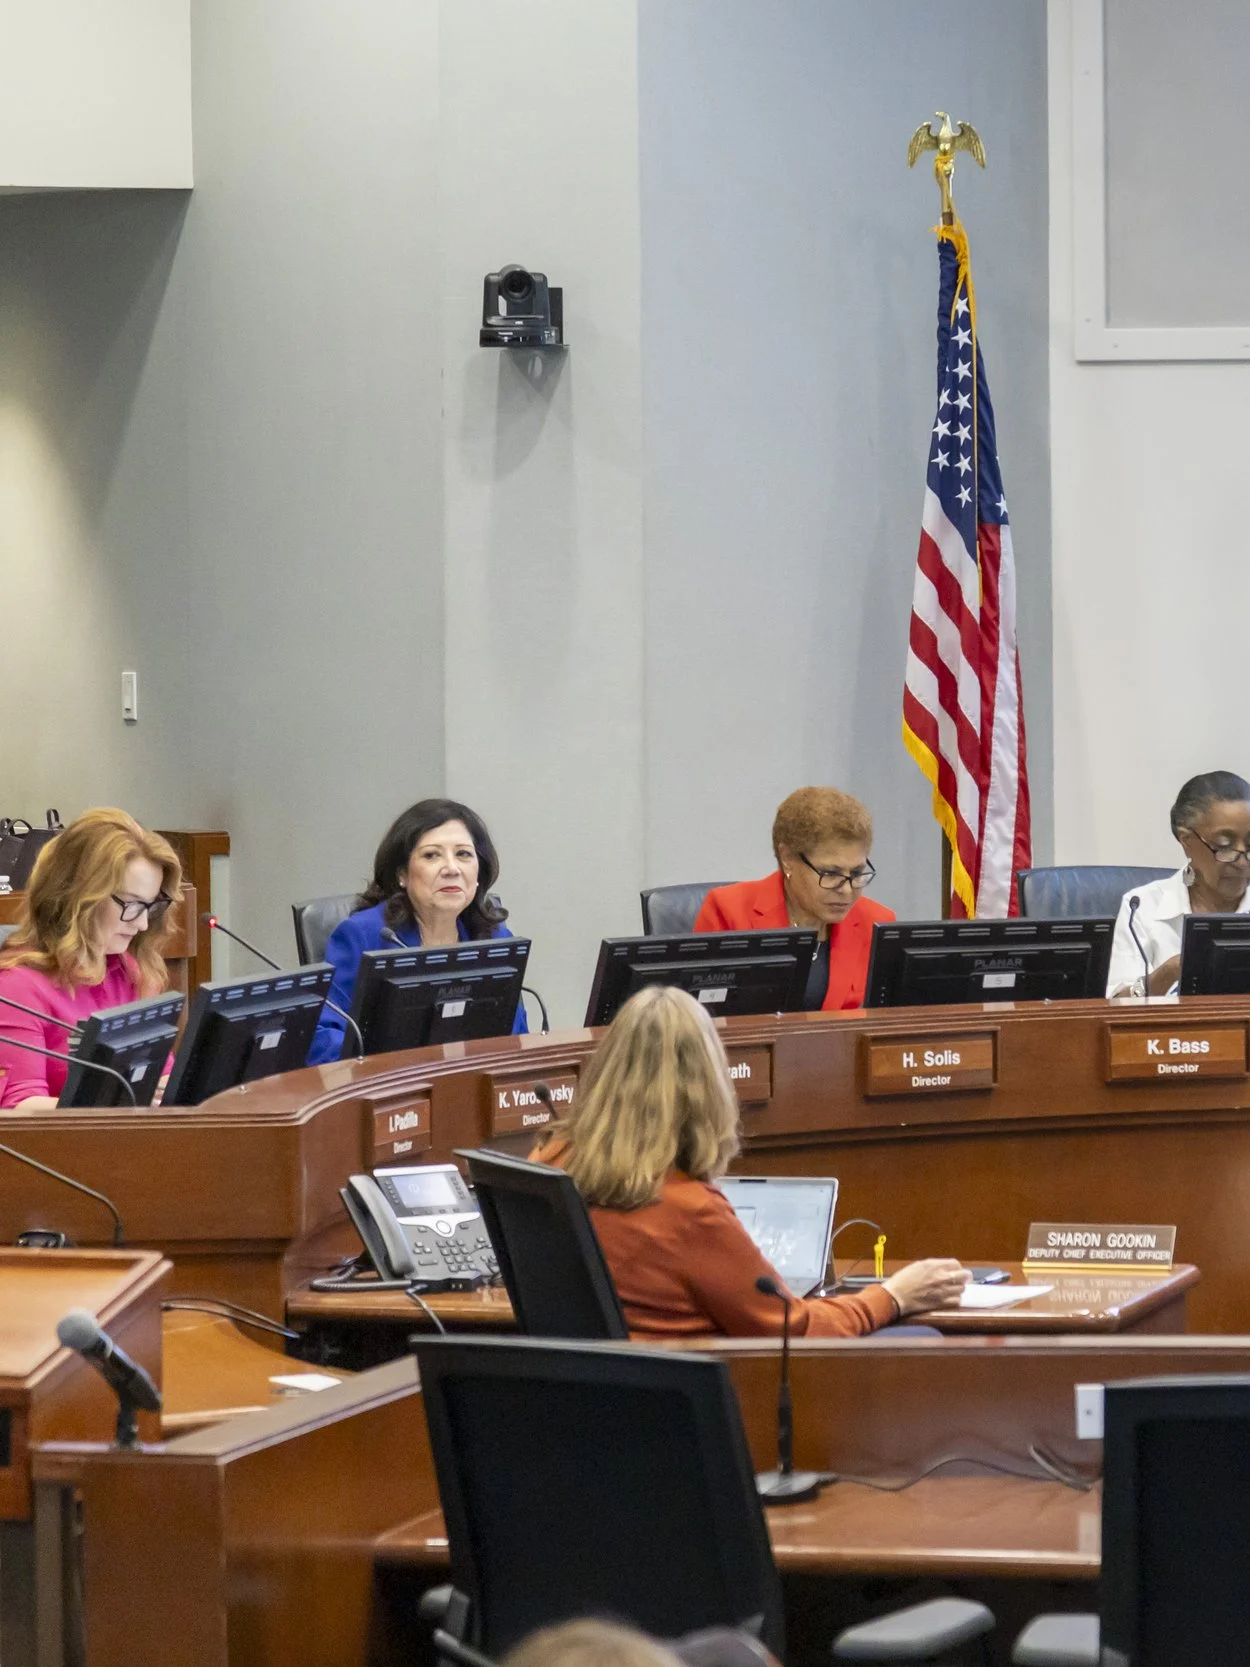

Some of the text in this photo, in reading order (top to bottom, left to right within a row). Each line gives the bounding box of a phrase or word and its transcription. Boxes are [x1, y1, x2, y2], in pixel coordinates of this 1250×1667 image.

[1146, 1038, 1210, 1055] K. Bass
[902, 1050, 961, 1068] H. Solis
[1157, 1063, 1200, 1074] Director
[911, 1074, 952, 1088] Director
[499, 1086, 575, 1109] K. Yarovsky
[394, 1111, 419, 1132] Padilla
[522, 1112, 551, 1127] Director
[393, 1140, 413, 1154] Director
[1047, 1231, 1157, 1249] SHARON GOOKIN
[1028, 1248, 1171, 1261] DEPUTY CHIEF EXECUTIVE OFFICER
